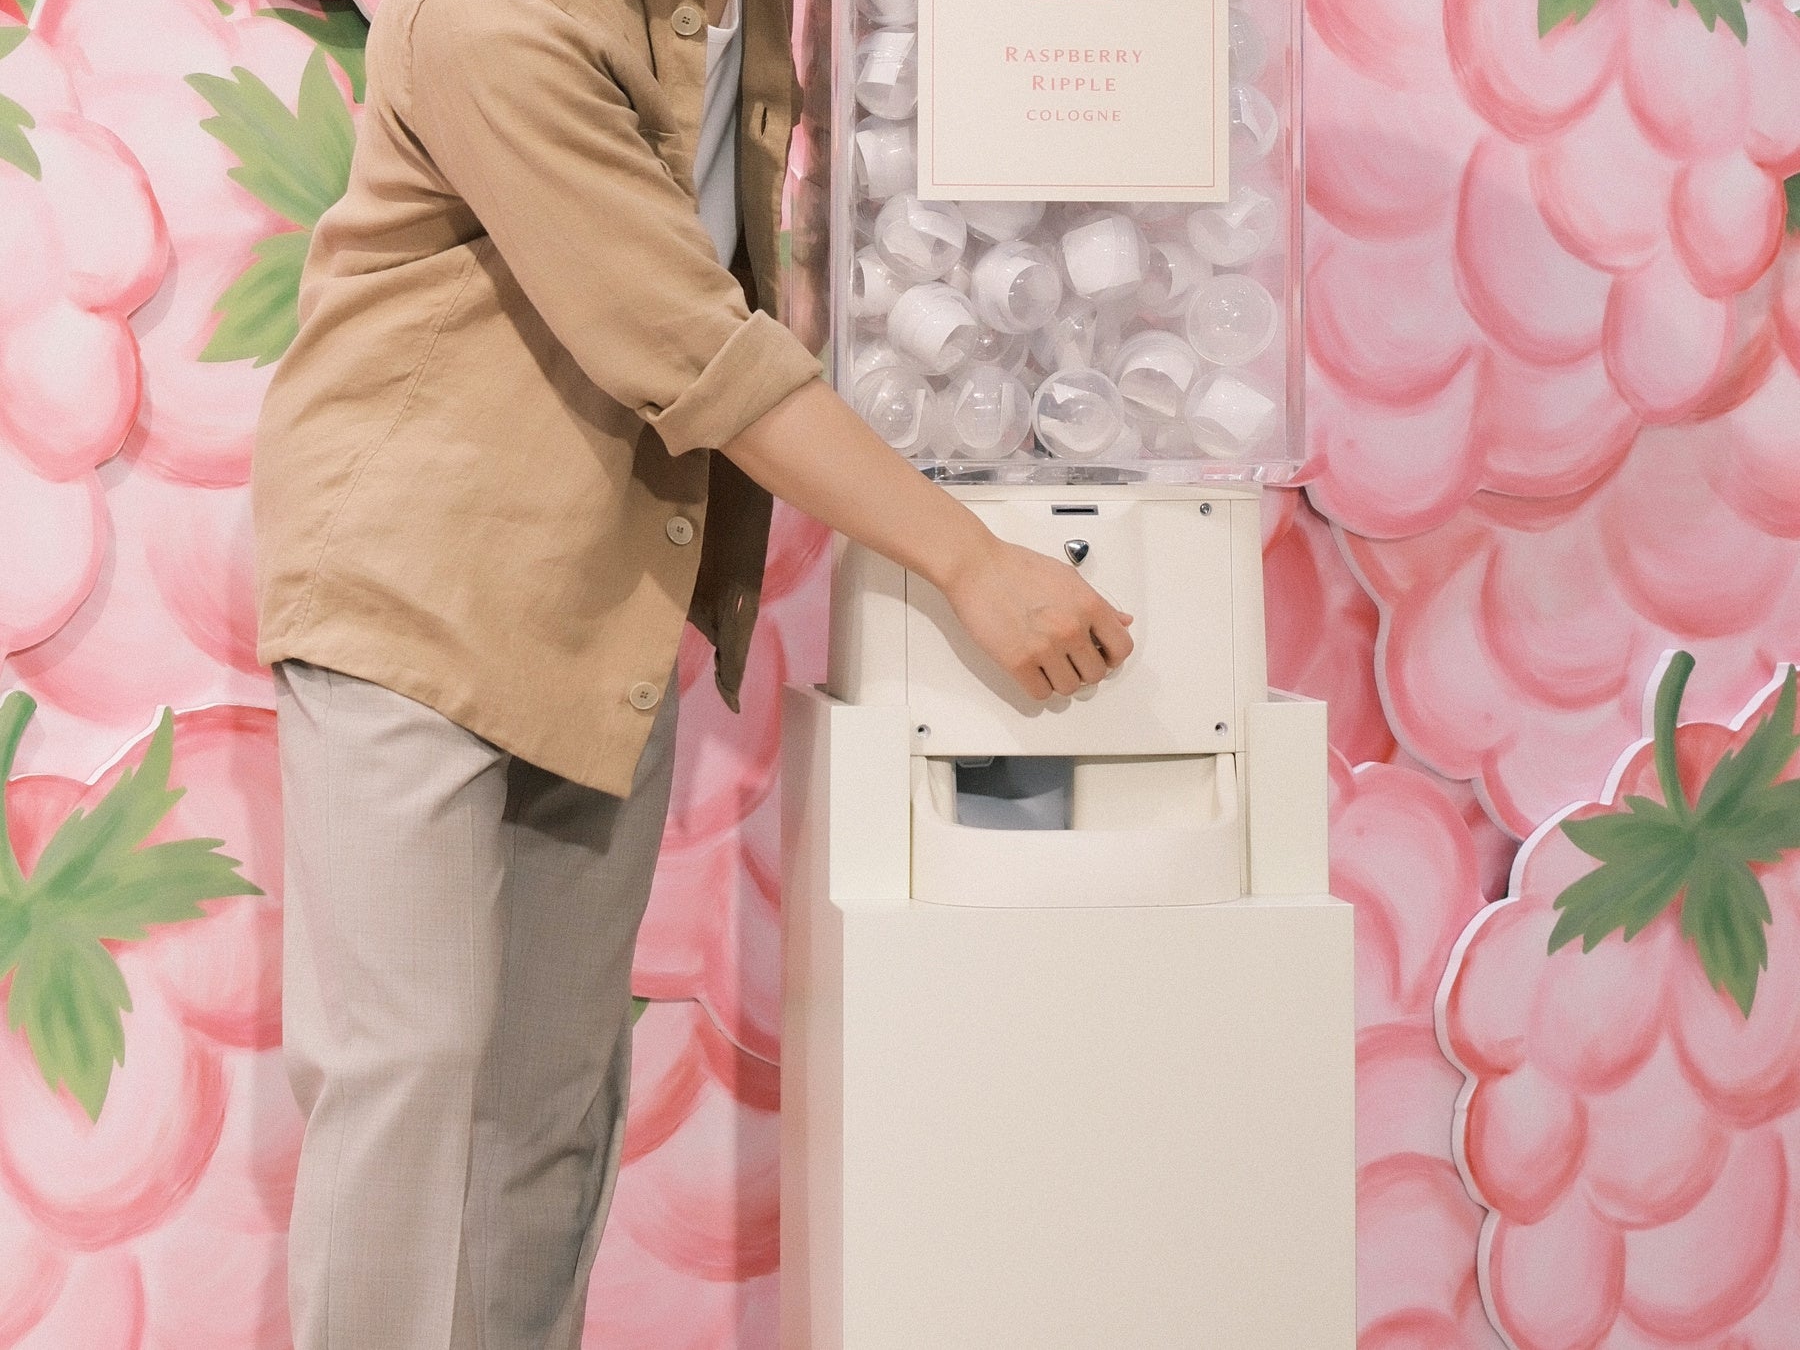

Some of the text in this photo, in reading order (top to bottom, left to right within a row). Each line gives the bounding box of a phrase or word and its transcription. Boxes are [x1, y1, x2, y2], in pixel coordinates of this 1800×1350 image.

[1004, 46, 1144, 64] RASPBERRY
[1031, 74, 1117, 91] RIPPLE
[1026, 109, 1122, 123] COLOGNE
